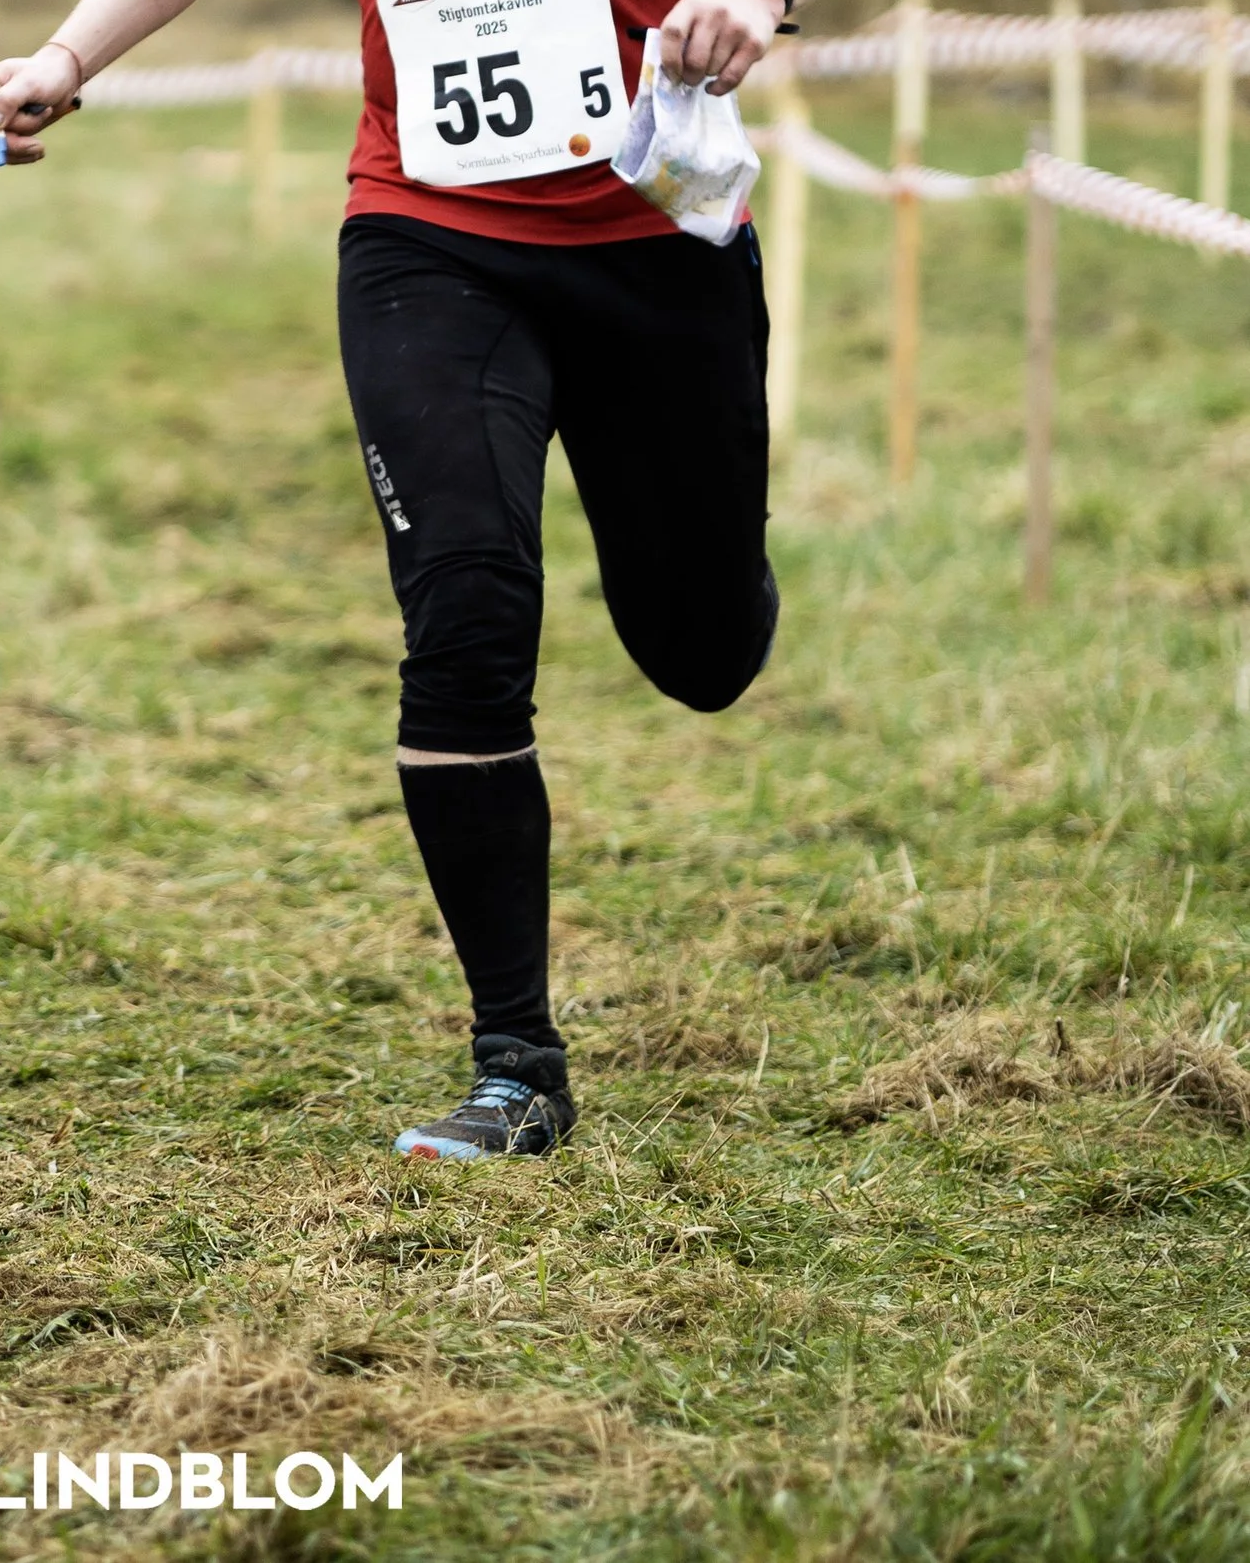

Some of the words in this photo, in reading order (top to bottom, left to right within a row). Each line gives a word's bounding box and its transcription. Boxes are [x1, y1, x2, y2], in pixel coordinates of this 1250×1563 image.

[475, 19, 509, 37] 2025
[432, 50, 534, 146] 55
[579, 66, 612, 119] 5
[512, 143, 565, 164] Sparbank
